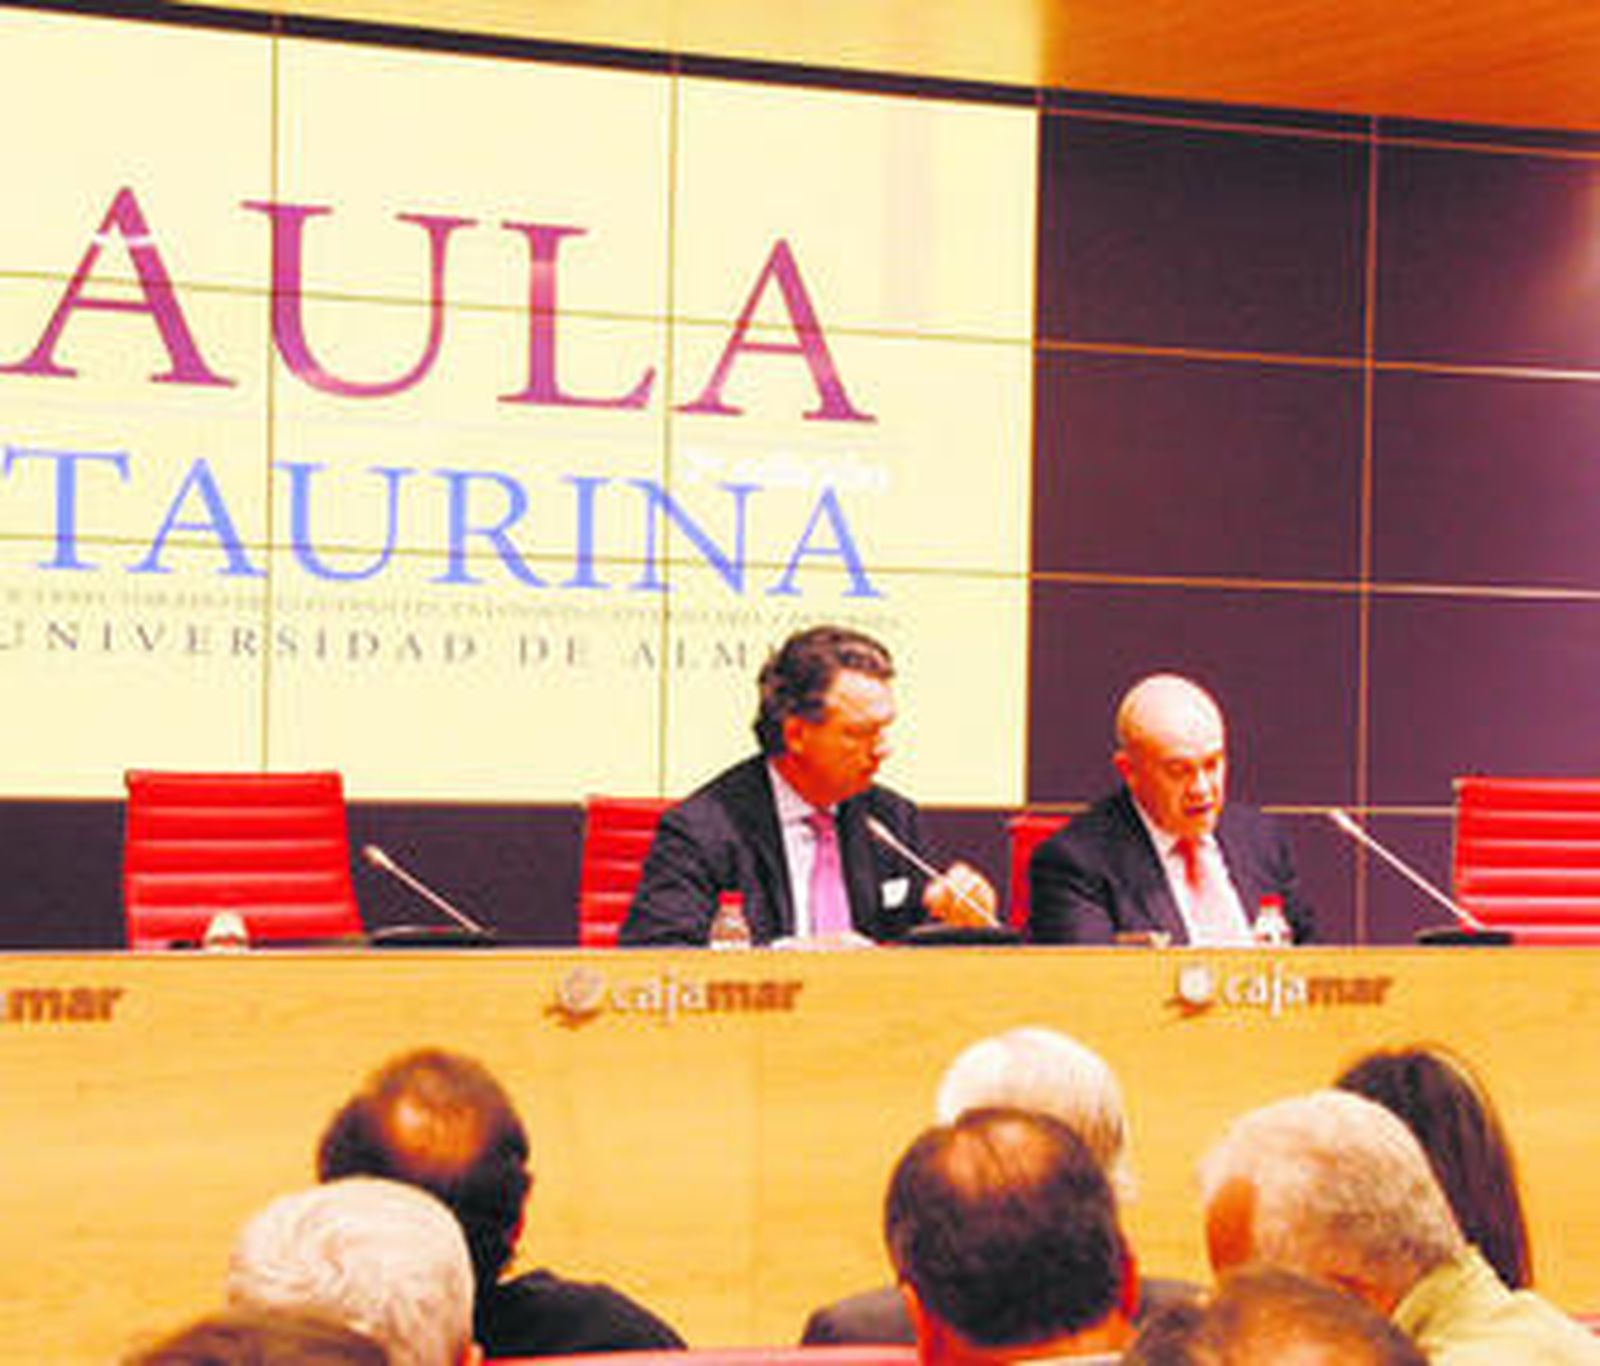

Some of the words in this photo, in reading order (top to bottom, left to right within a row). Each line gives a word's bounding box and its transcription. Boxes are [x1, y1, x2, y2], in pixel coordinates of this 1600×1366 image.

[0, 185, 877, 424] AULA
[3, 446, 886, 600] TAURINA
[518, 634, 590, 668] DE
[635, 636, 778, 672] ALM
[0, 985, 124, 1024] mar
[610, 966, 803, 1026] cajamar
[1223, 962, 1394, 1017] cajamar
